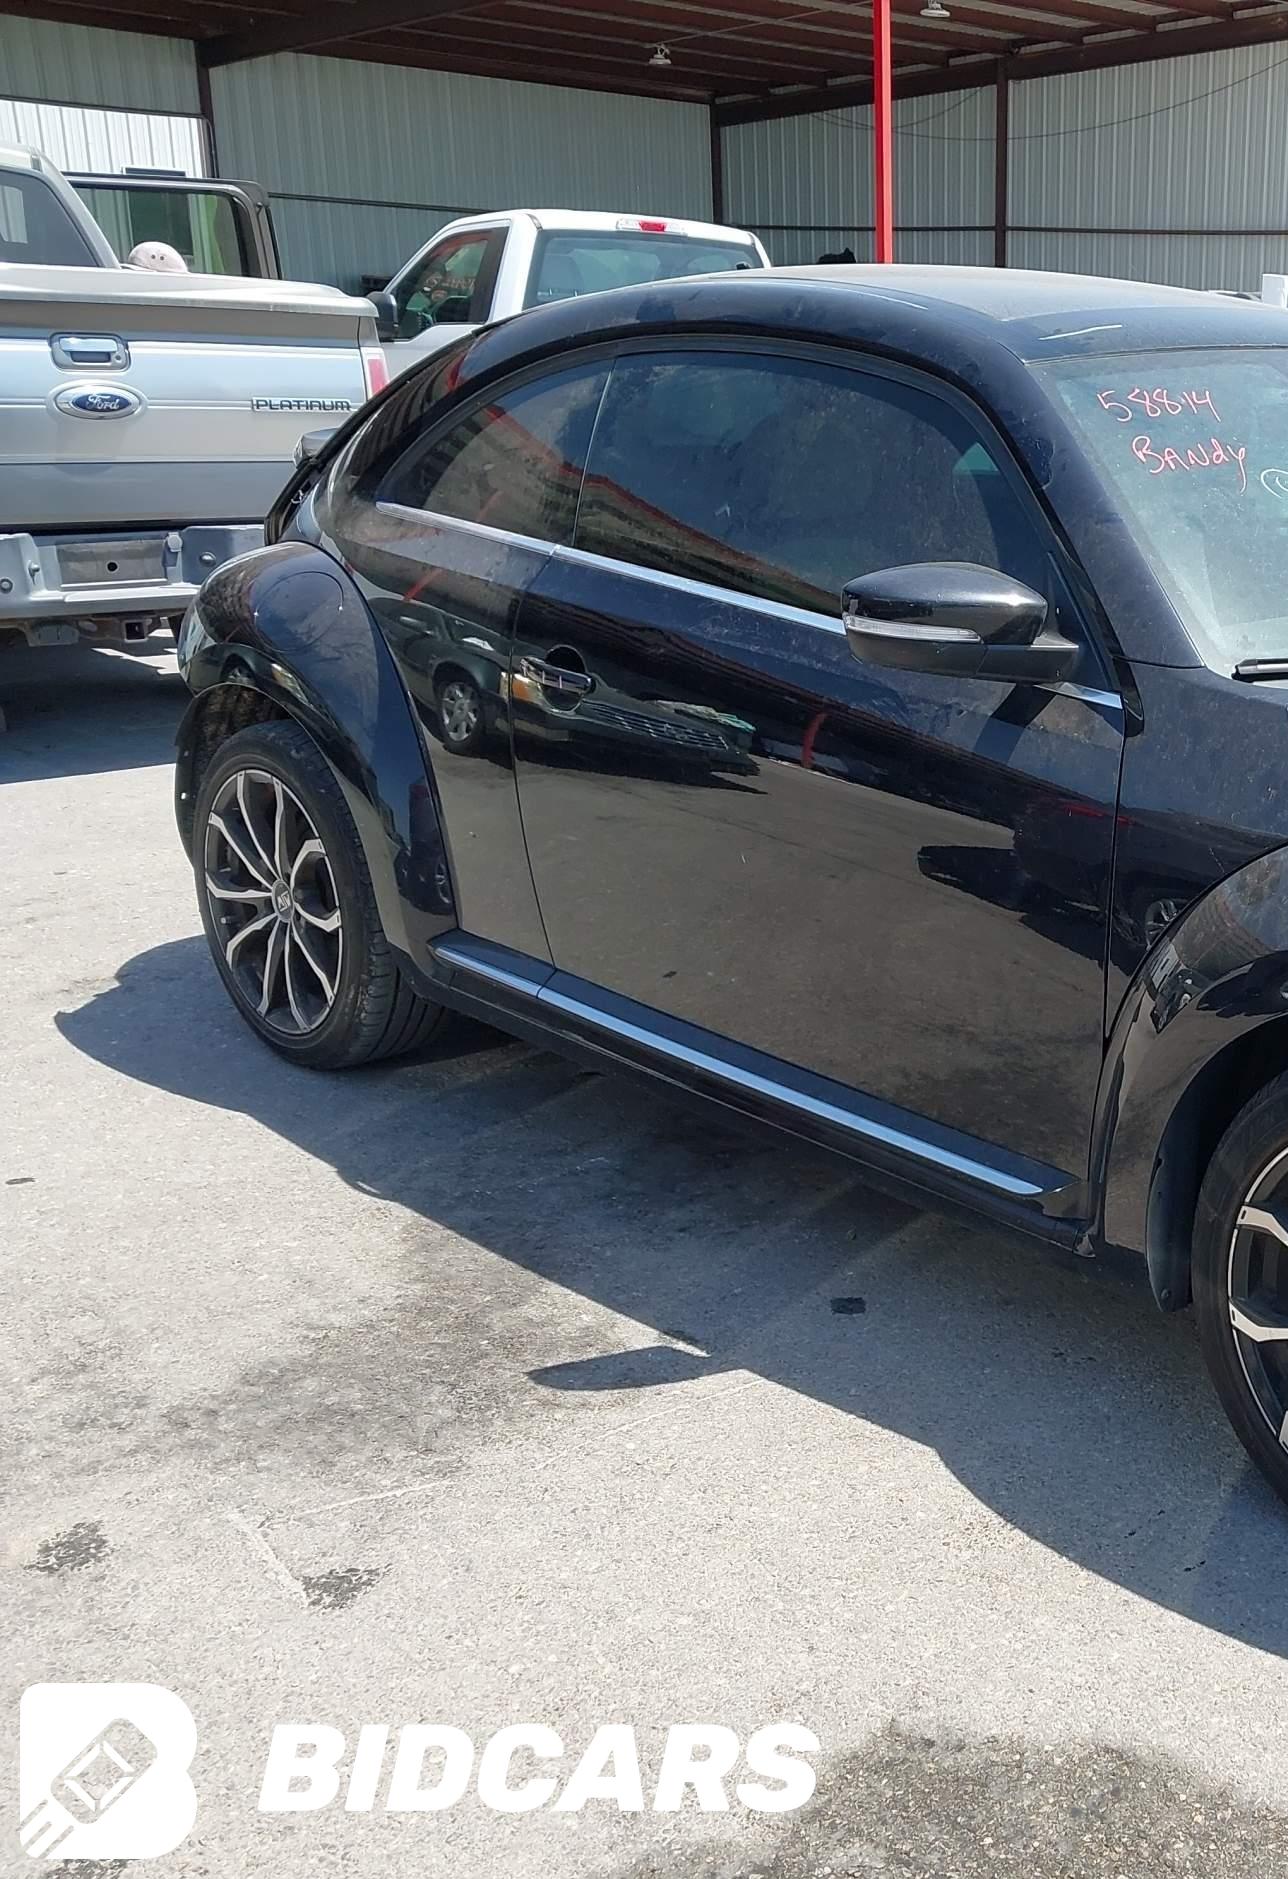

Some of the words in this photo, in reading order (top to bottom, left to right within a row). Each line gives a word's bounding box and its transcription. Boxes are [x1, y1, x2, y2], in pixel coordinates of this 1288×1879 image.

[86, 394, 120, 411] Ford
[255, 399, 351, 411] PLATINUM
[1097, 388, 1221, 422] 58814
